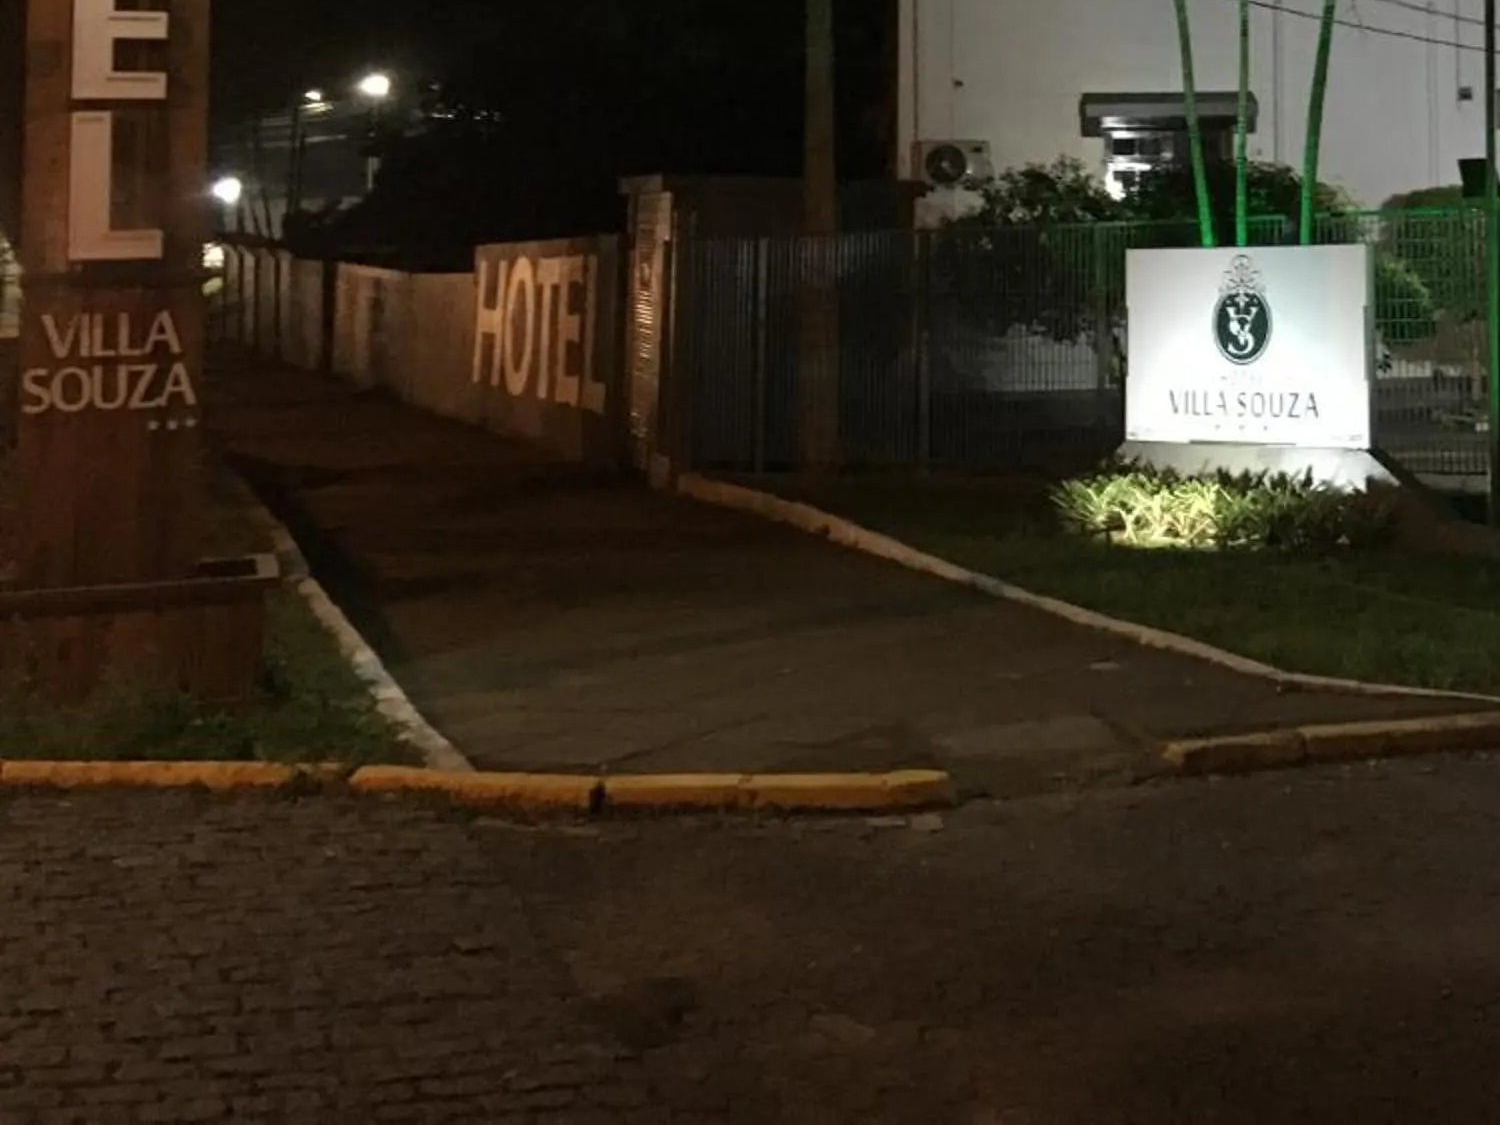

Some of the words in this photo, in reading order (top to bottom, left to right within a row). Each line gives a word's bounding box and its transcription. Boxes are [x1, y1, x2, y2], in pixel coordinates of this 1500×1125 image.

[41, 309, 182, 359] VILLA
[472, 254, 605, 416] HOTEL
[21, 362, 197, 414] SOUZA
[1168, 389, 1229, 416] VILLA
[1236, 390, 1320, 419] SOUZA
